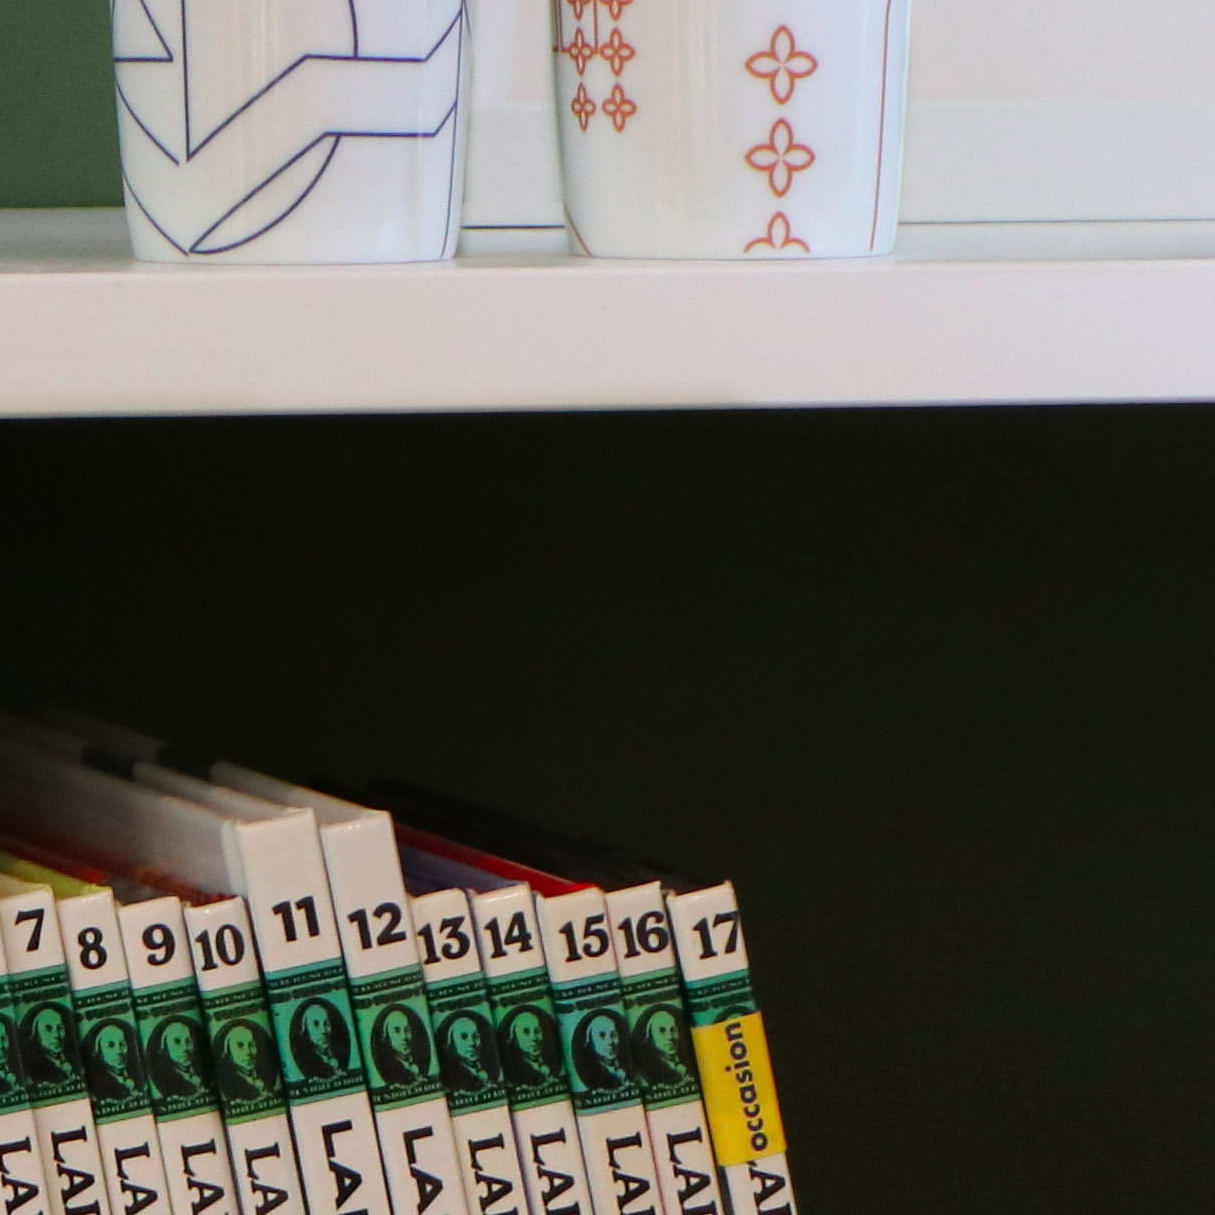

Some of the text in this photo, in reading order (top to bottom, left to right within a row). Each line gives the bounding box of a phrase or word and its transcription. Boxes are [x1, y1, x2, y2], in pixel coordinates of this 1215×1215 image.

[15, 909, 44, 951] 7
[273, 897, 319, 942] 11
[348, 903, 406, 949] 12
[417, 915, 471, 965] 13
[485, 911, 534, 959] 14
[559, 914, 609, 962] 15
[618, 911, 670, 959] 16
[693, 911, 739, 959] 17
[78, 928, 107, 969] 8
[143, 924, 175, 966] 9
[194, 924, 245, 972] 10
[724, 1020, 768, 1152] occasion
[181, 1138, 229, 1215] LA
[322, 1120, 368, 1215] LA
[468, 1132, 518, 1215] LA
[606, 1132, 656, 1215] LA
